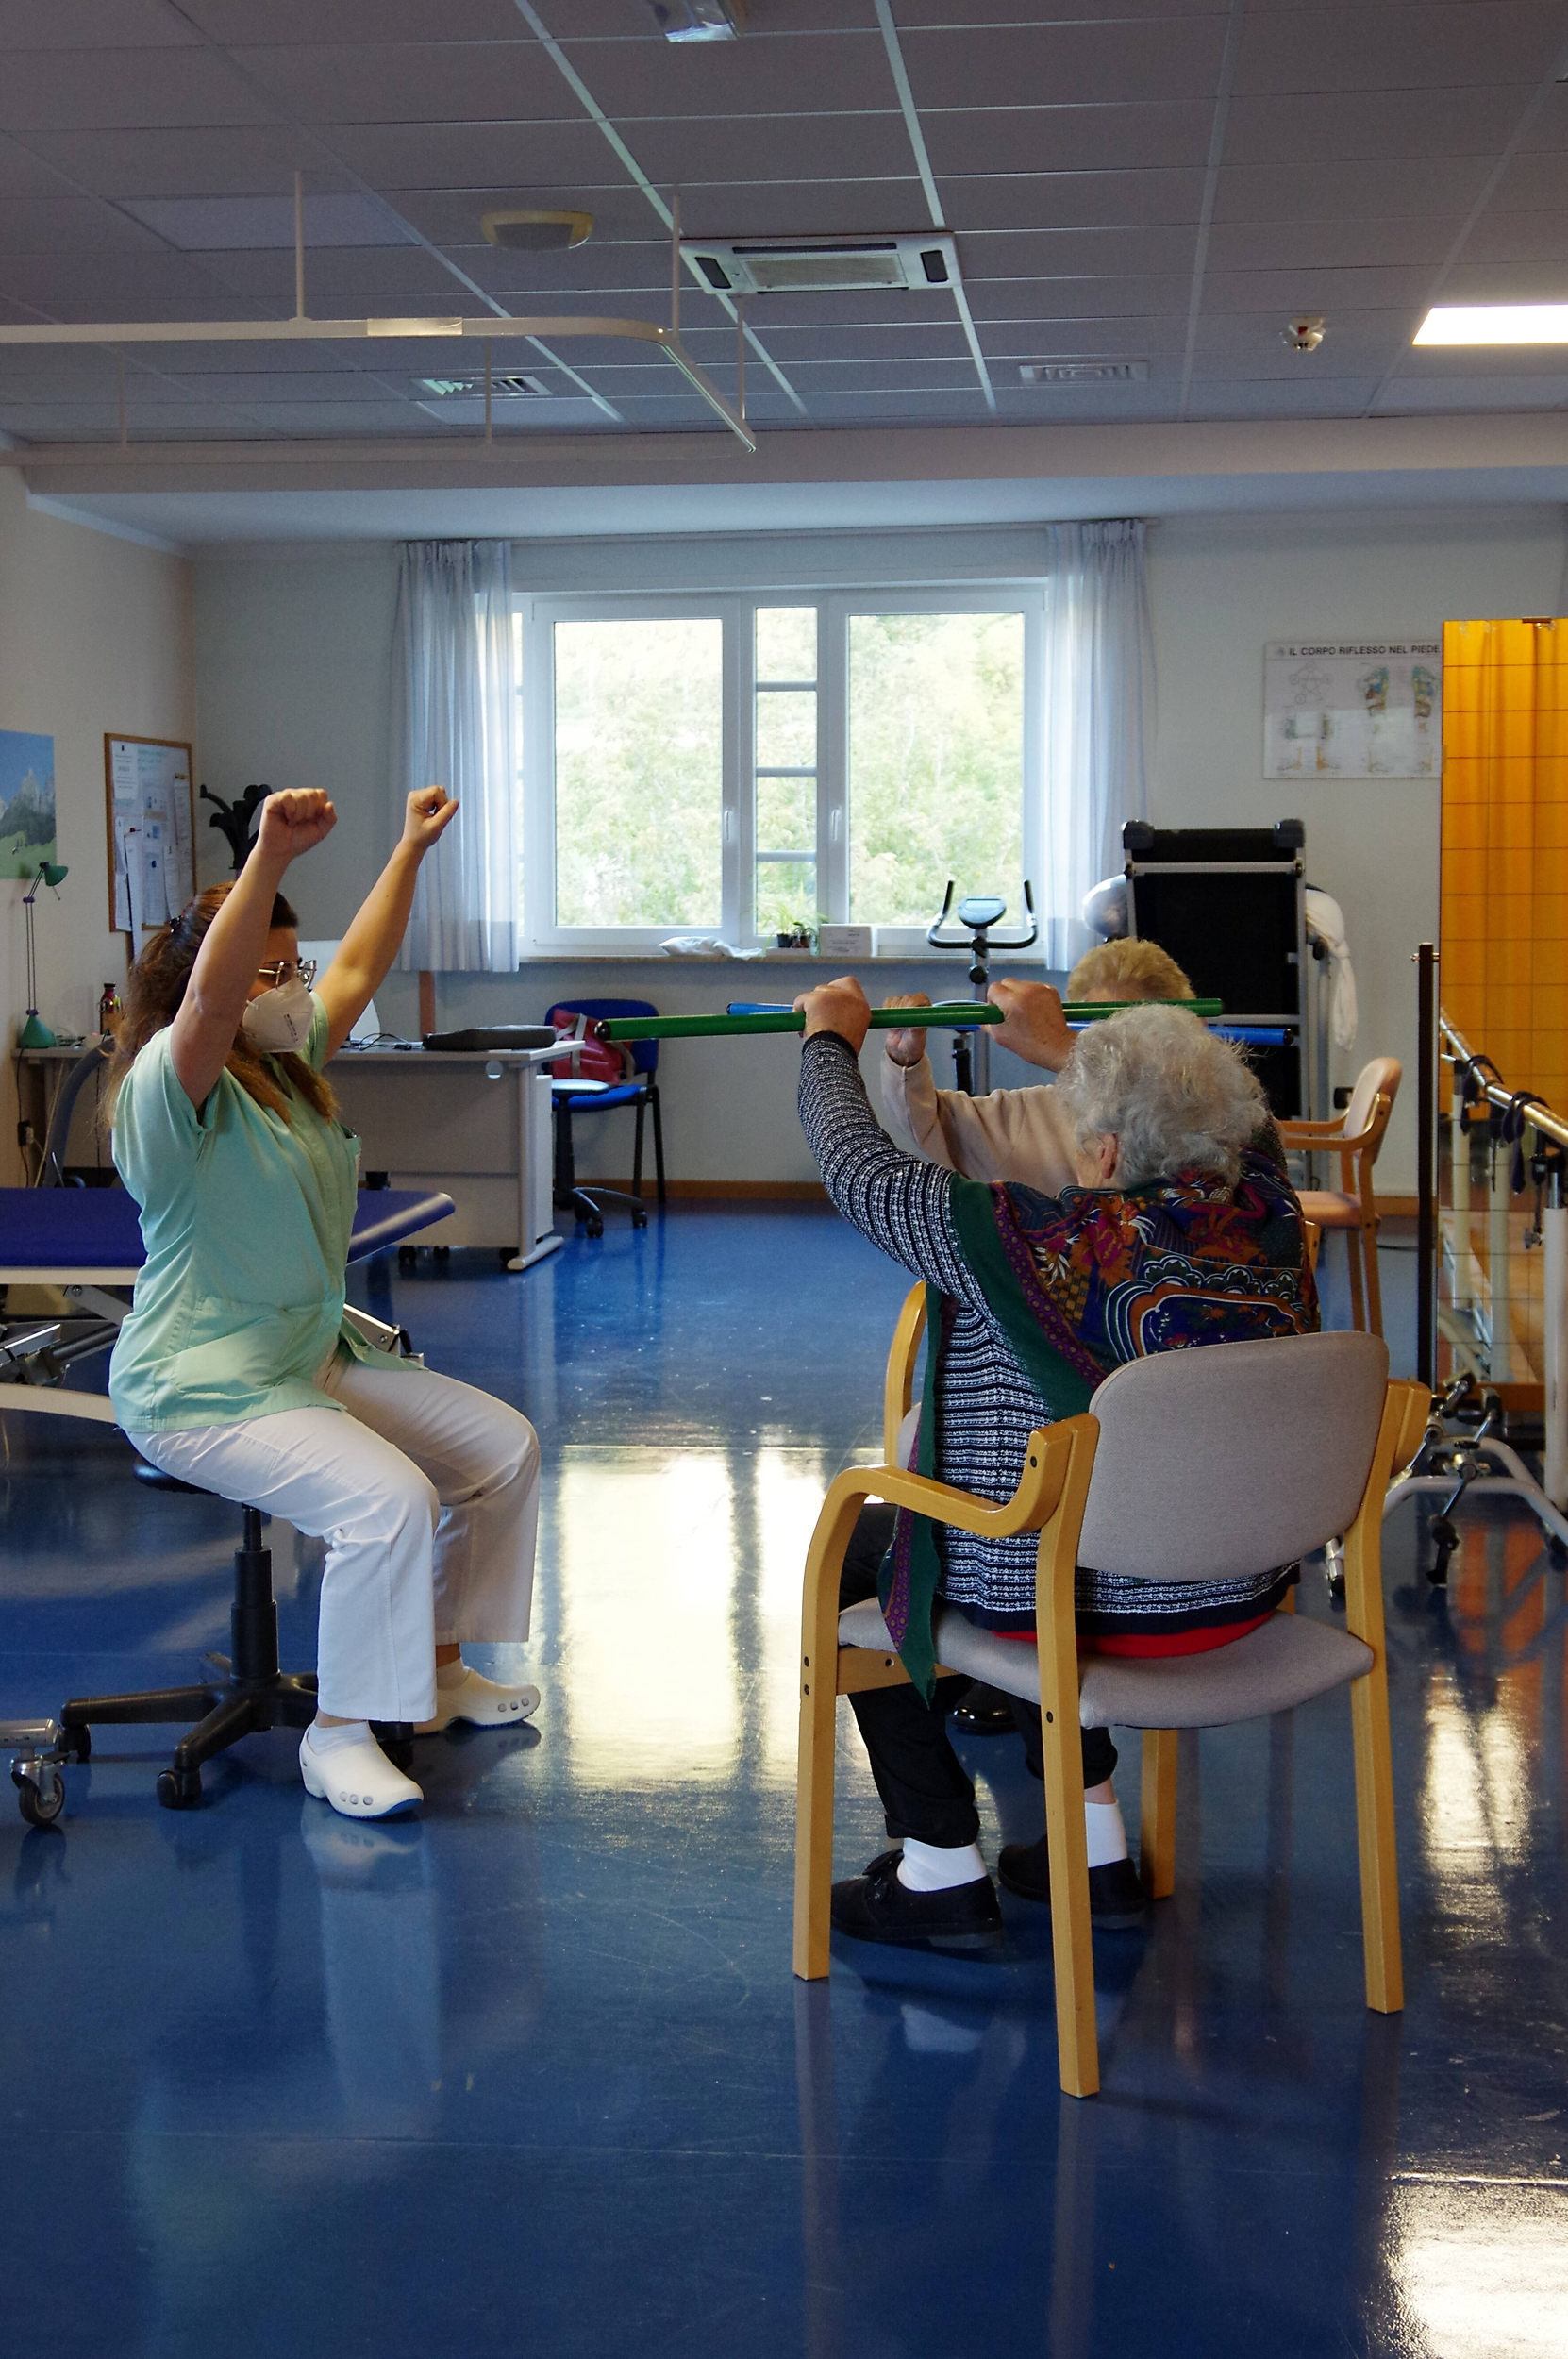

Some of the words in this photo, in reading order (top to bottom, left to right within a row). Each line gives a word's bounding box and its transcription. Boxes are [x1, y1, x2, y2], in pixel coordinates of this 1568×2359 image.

[1289, 647, 1297, 656] IL
[1300, 646, 1336, 656] CORPO
[1339, 646, 1386, 655] RIFLESSO
[1389, 645, 1408, 654] NEL
[1411, 644, 1441, 653] PIEDE
